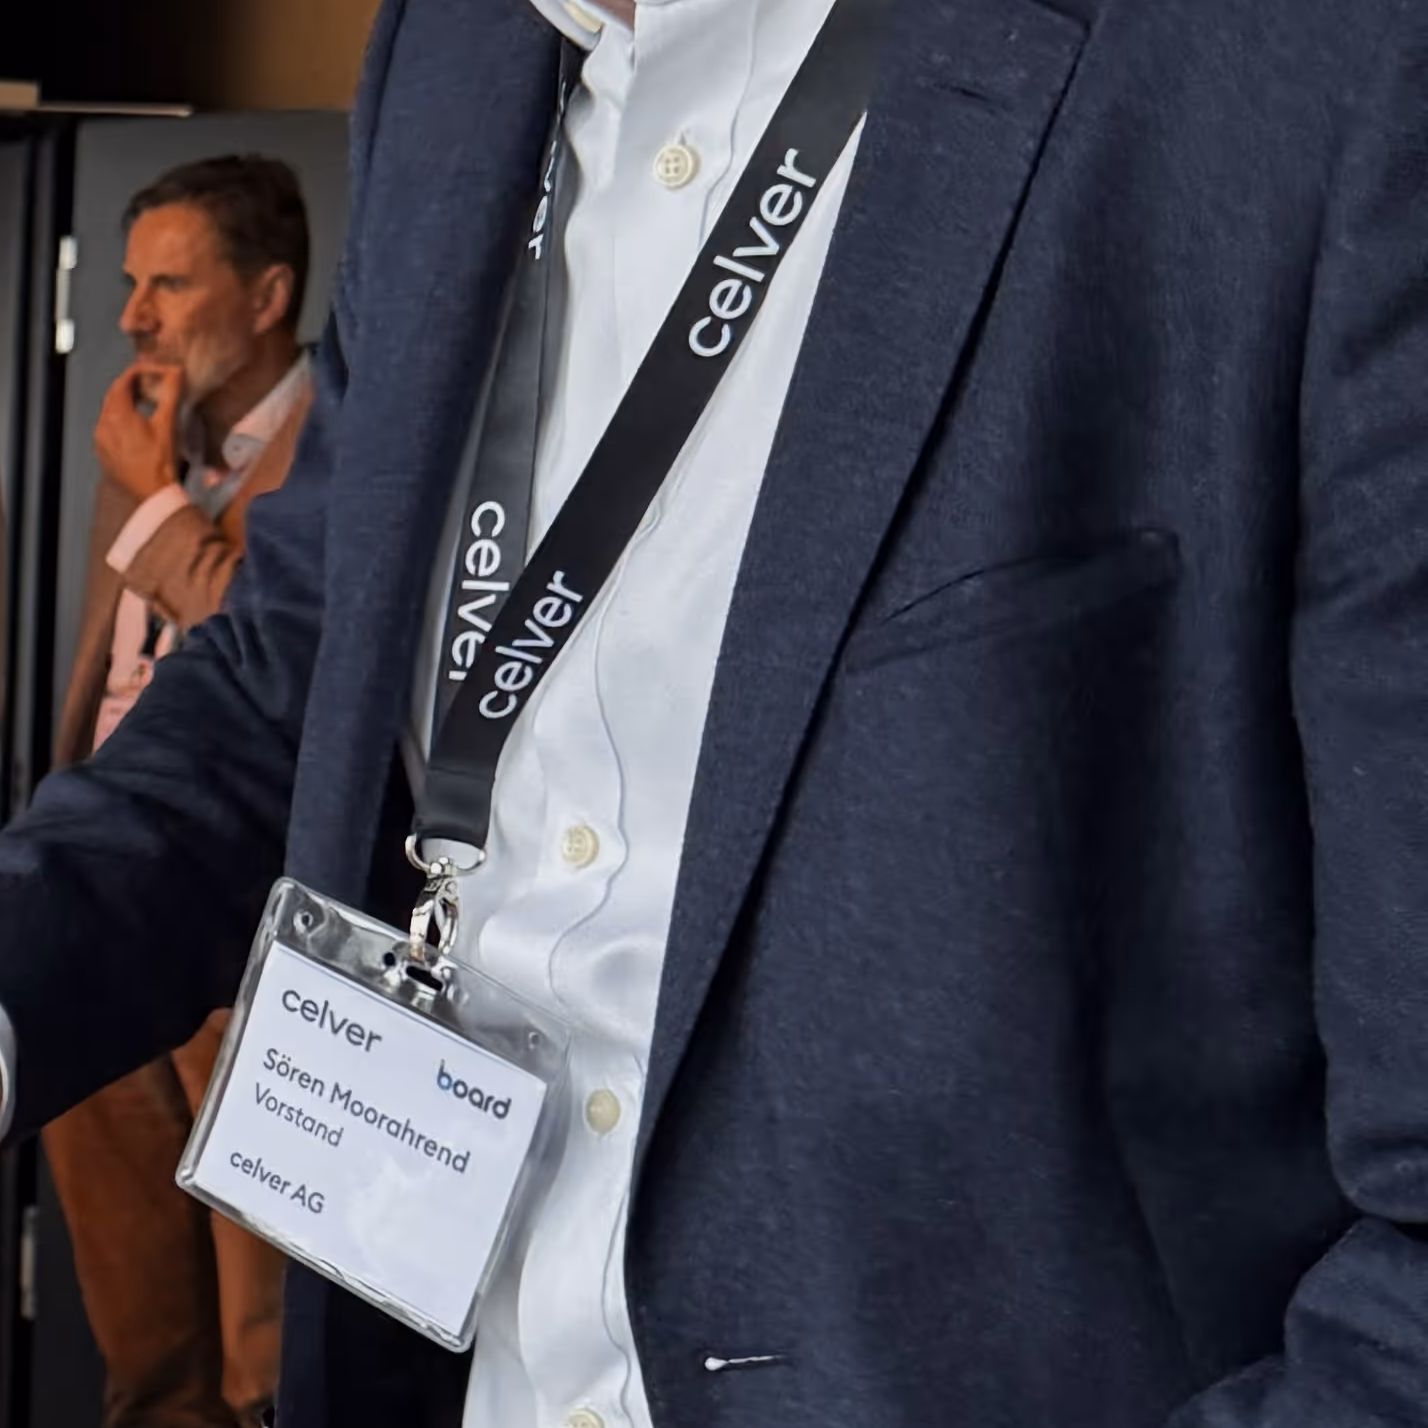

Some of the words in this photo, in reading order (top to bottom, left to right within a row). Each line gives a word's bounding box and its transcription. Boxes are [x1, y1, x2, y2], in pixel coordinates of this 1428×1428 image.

[689, 148, 816, 358] celver
[478, 570, 583, 719] celver
[281, 988, 382, 1053] celver
[254, 1083, 345, 1148] Vorstand
[263, 1048, 326, 1098] Sören
[330, 1083, 471, 1174] Moorahrend
[436, 1060, 512, 1120] board
[230, 1150, 291, 1195] celver
[290, 1184, 326, 1214] AG
